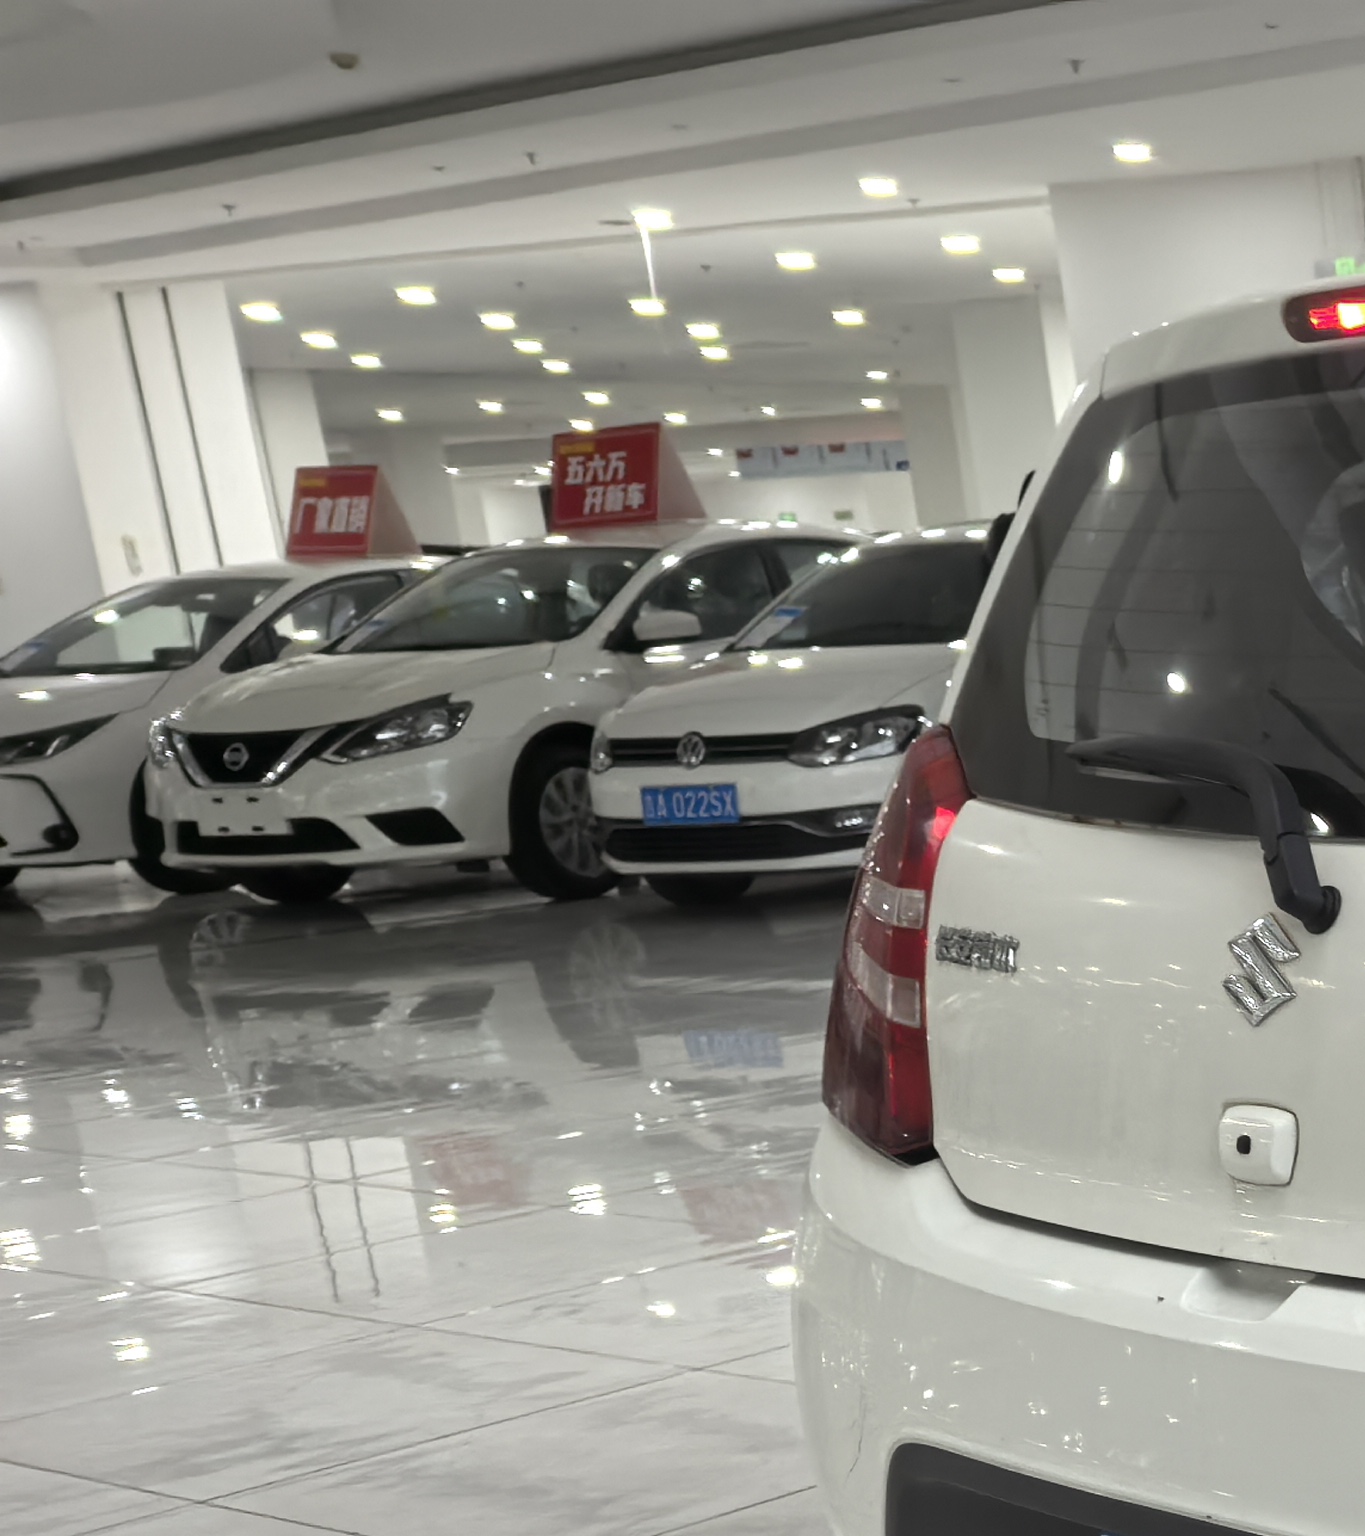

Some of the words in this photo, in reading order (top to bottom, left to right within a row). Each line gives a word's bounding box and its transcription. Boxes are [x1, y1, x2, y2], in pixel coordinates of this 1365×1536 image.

[564, 451, 628, 486] 五六万
[583, 482, 647, 516] 开新车
